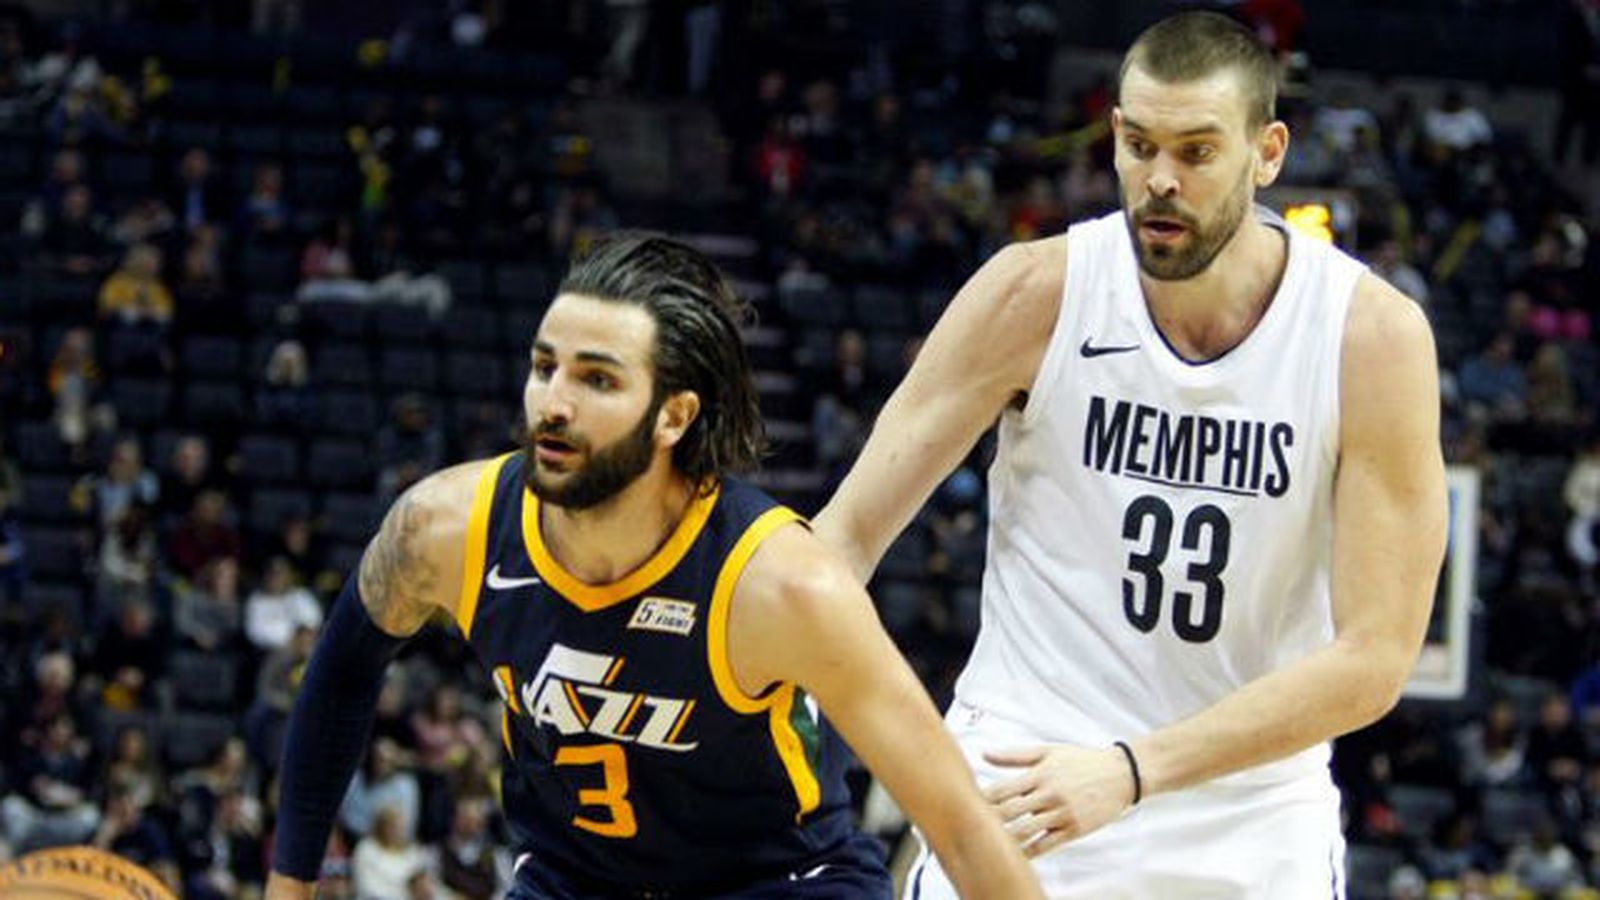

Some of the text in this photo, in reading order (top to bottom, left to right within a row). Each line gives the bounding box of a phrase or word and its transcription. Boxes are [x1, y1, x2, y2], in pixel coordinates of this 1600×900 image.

[1083, 396, 1294, 498] MEMPHIS
[1122, 495, 1231, 643] 33
[521, 642, 698, 751] JAZZ
[554, 744, 638, 839] 3
